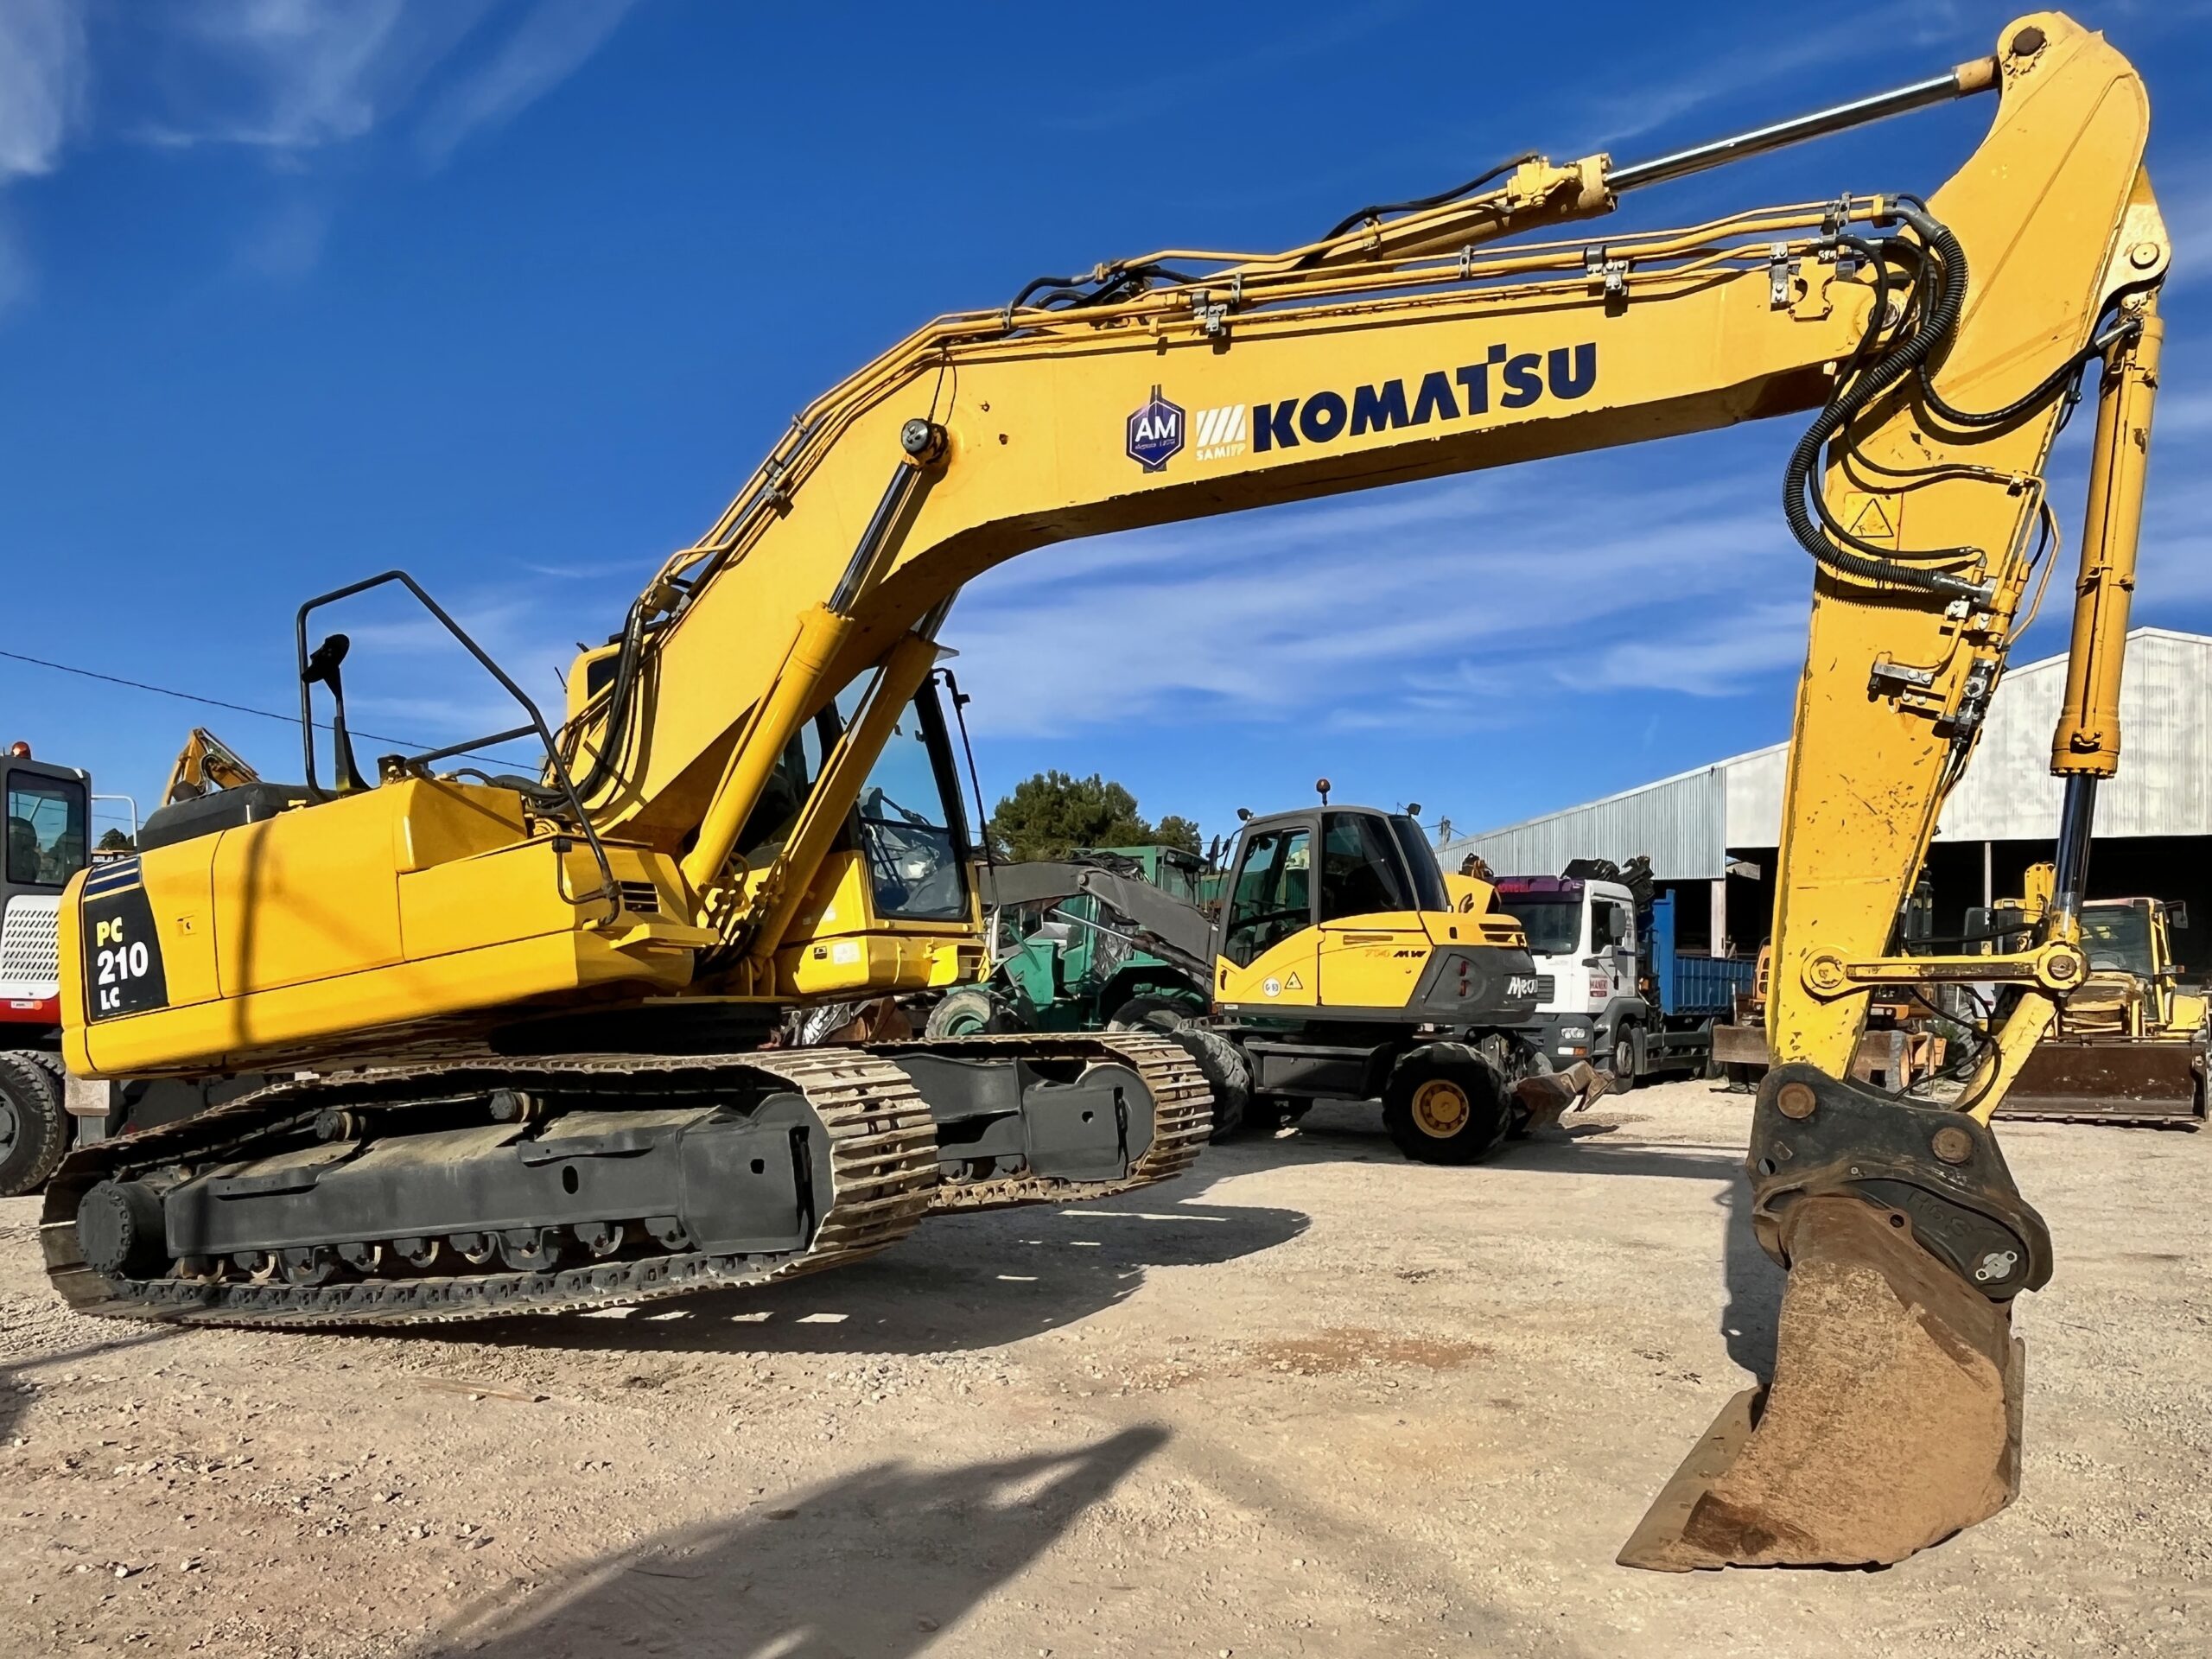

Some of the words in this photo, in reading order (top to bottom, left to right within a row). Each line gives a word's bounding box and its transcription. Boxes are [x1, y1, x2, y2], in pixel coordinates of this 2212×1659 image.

[1253, 342, 1597, 453] KOMATSU
[1135, 413, 1176, 442] AM
[96, 916, 124, 947] PC
[97, 941, 149, 985] 210
[100, 987, 121, 1010] LC
